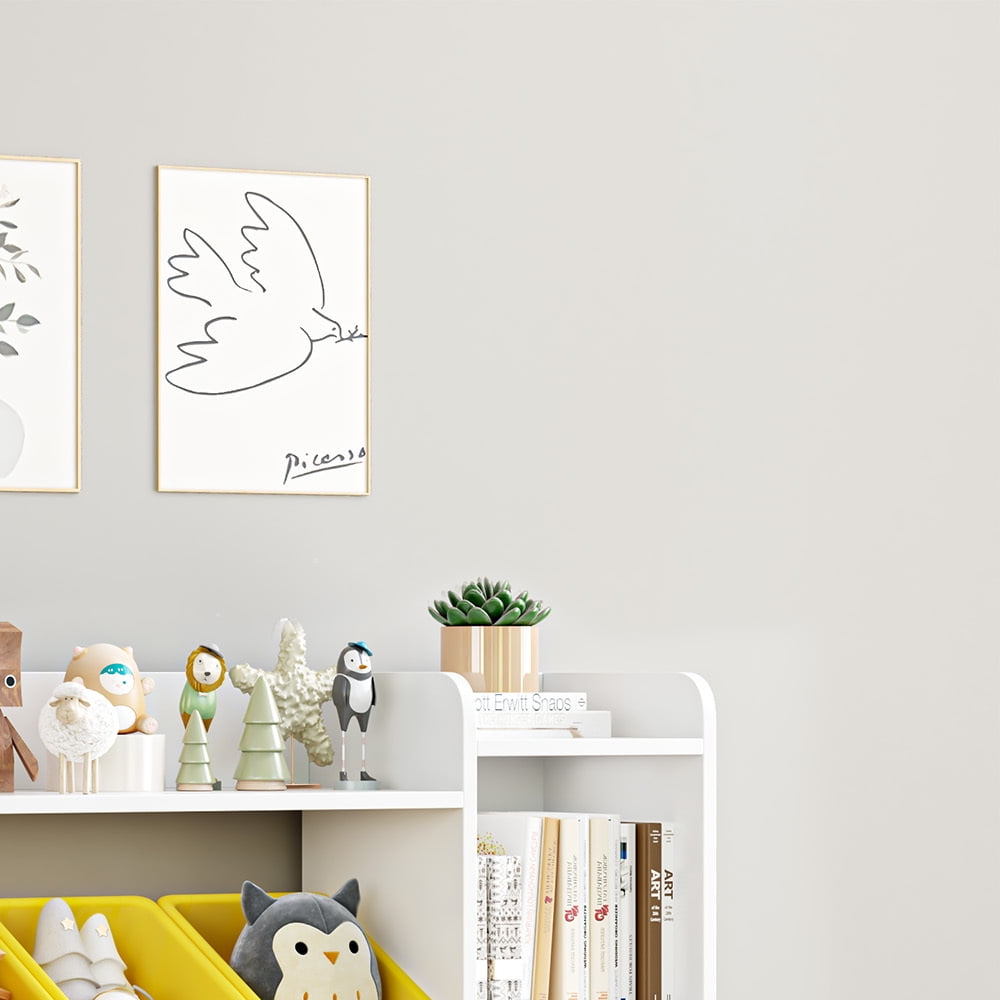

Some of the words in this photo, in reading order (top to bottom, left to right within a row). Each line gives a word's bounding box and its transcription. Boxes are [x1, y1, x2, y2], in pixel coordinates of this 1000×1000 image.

[495, 694, 528, 711] Erwitt
[650, 869, 661, 900] ART
[664, 869, 674, 900] ART
